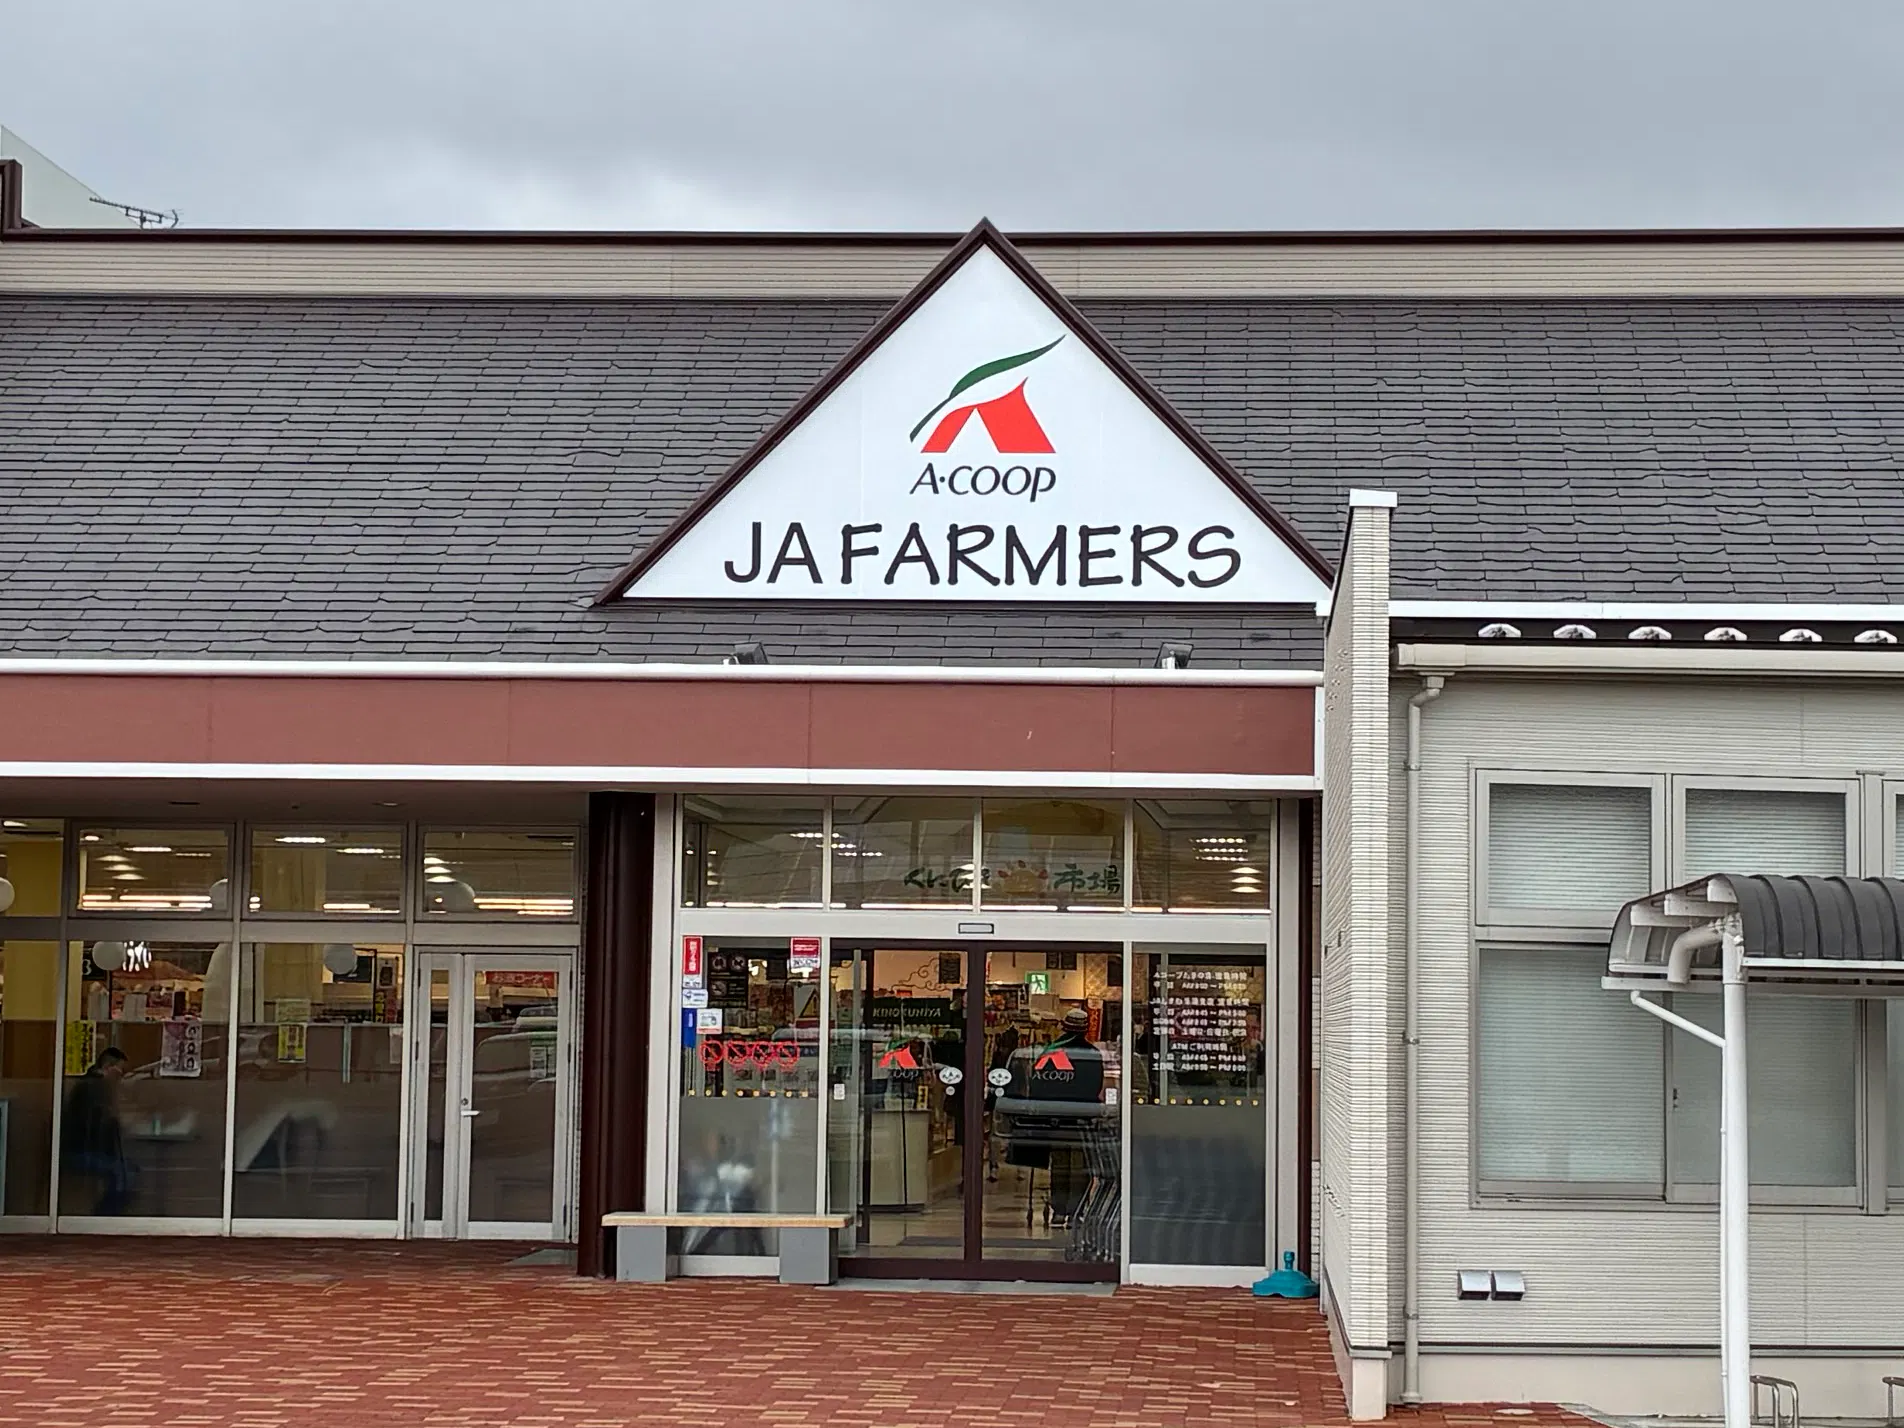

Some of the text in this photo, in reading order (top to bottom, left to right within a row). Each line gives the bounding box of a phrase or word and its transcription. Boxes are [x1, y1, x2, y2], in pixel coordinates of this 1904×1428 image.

[724, 521, 1242, 589] JA FARMERS
[1053, 863, 1120, 895] 市場
